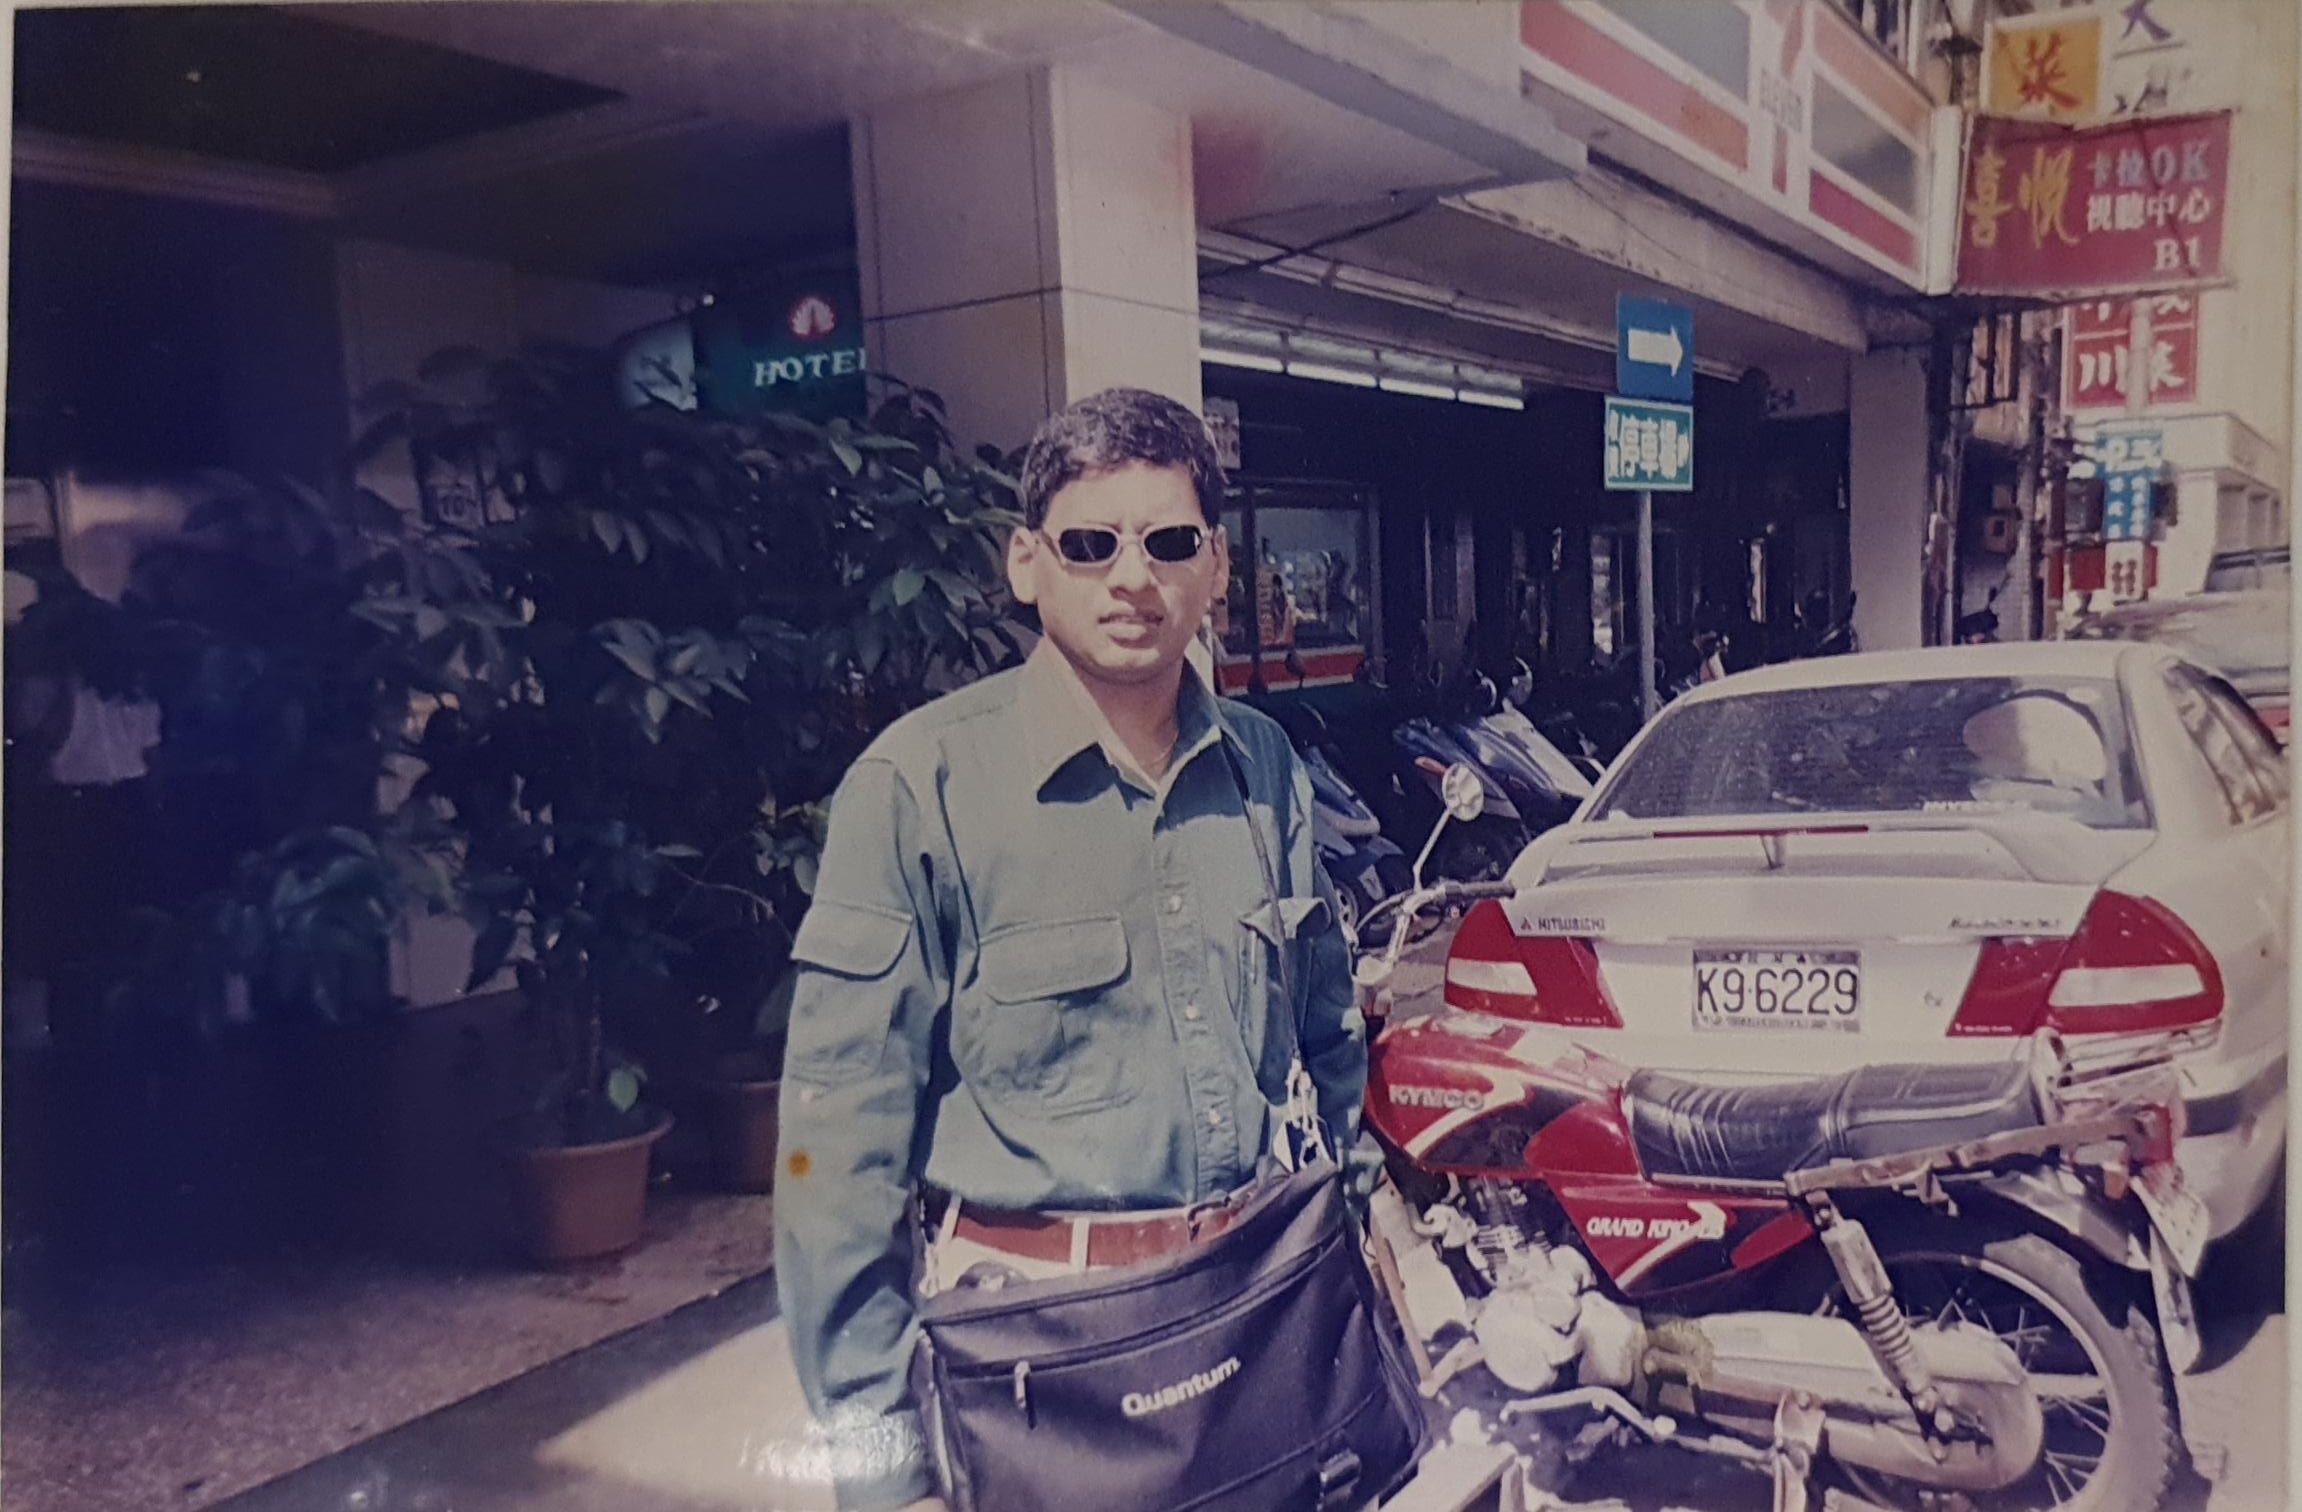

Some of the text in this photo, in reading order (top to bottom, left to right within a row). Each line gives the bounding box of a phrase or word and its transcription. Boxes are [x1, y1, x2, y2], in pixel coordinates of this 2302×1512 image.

[2153, 237, 2201, 271] B1
[1586, 1216, 1645, 1238] GRAND
[1121, 1356, 1242, 1418] Quantum
